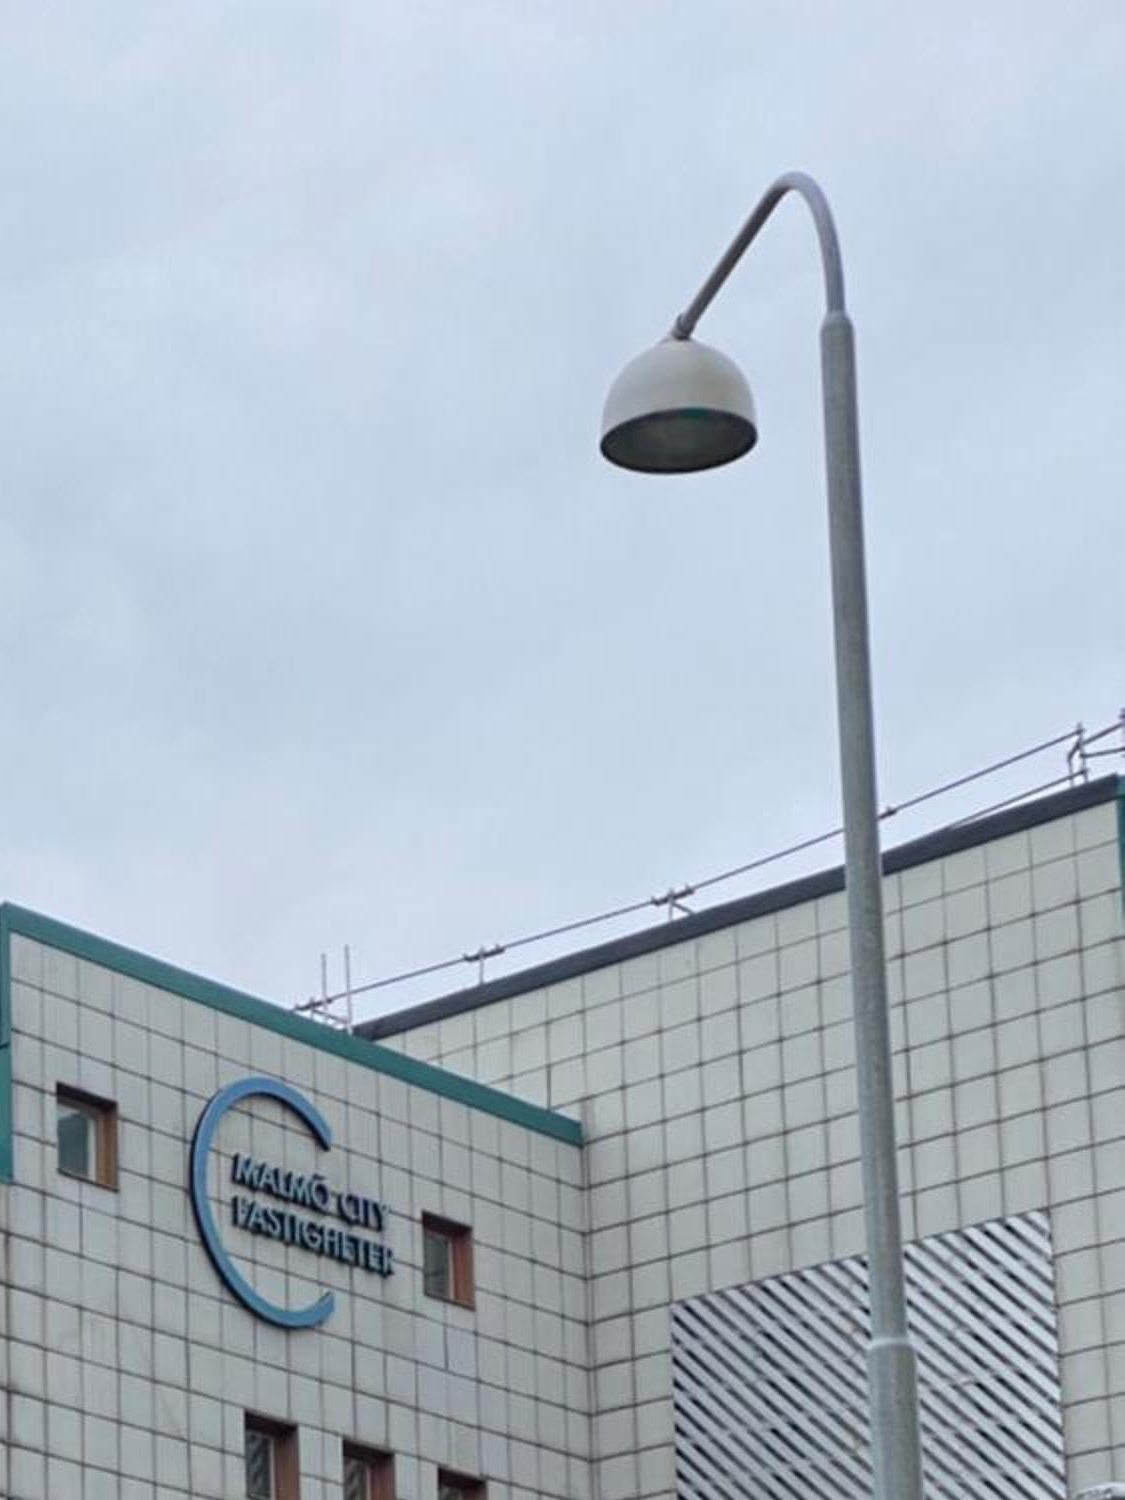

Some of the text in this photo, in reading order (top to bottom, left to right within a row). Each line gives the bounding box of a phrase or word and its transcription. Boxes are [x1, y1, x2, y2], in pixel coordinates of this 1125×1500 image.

[232, 1153, 391, 1231] MALMÖ CITY
[232, 1196, 395, 1278] FASTIGHETER
